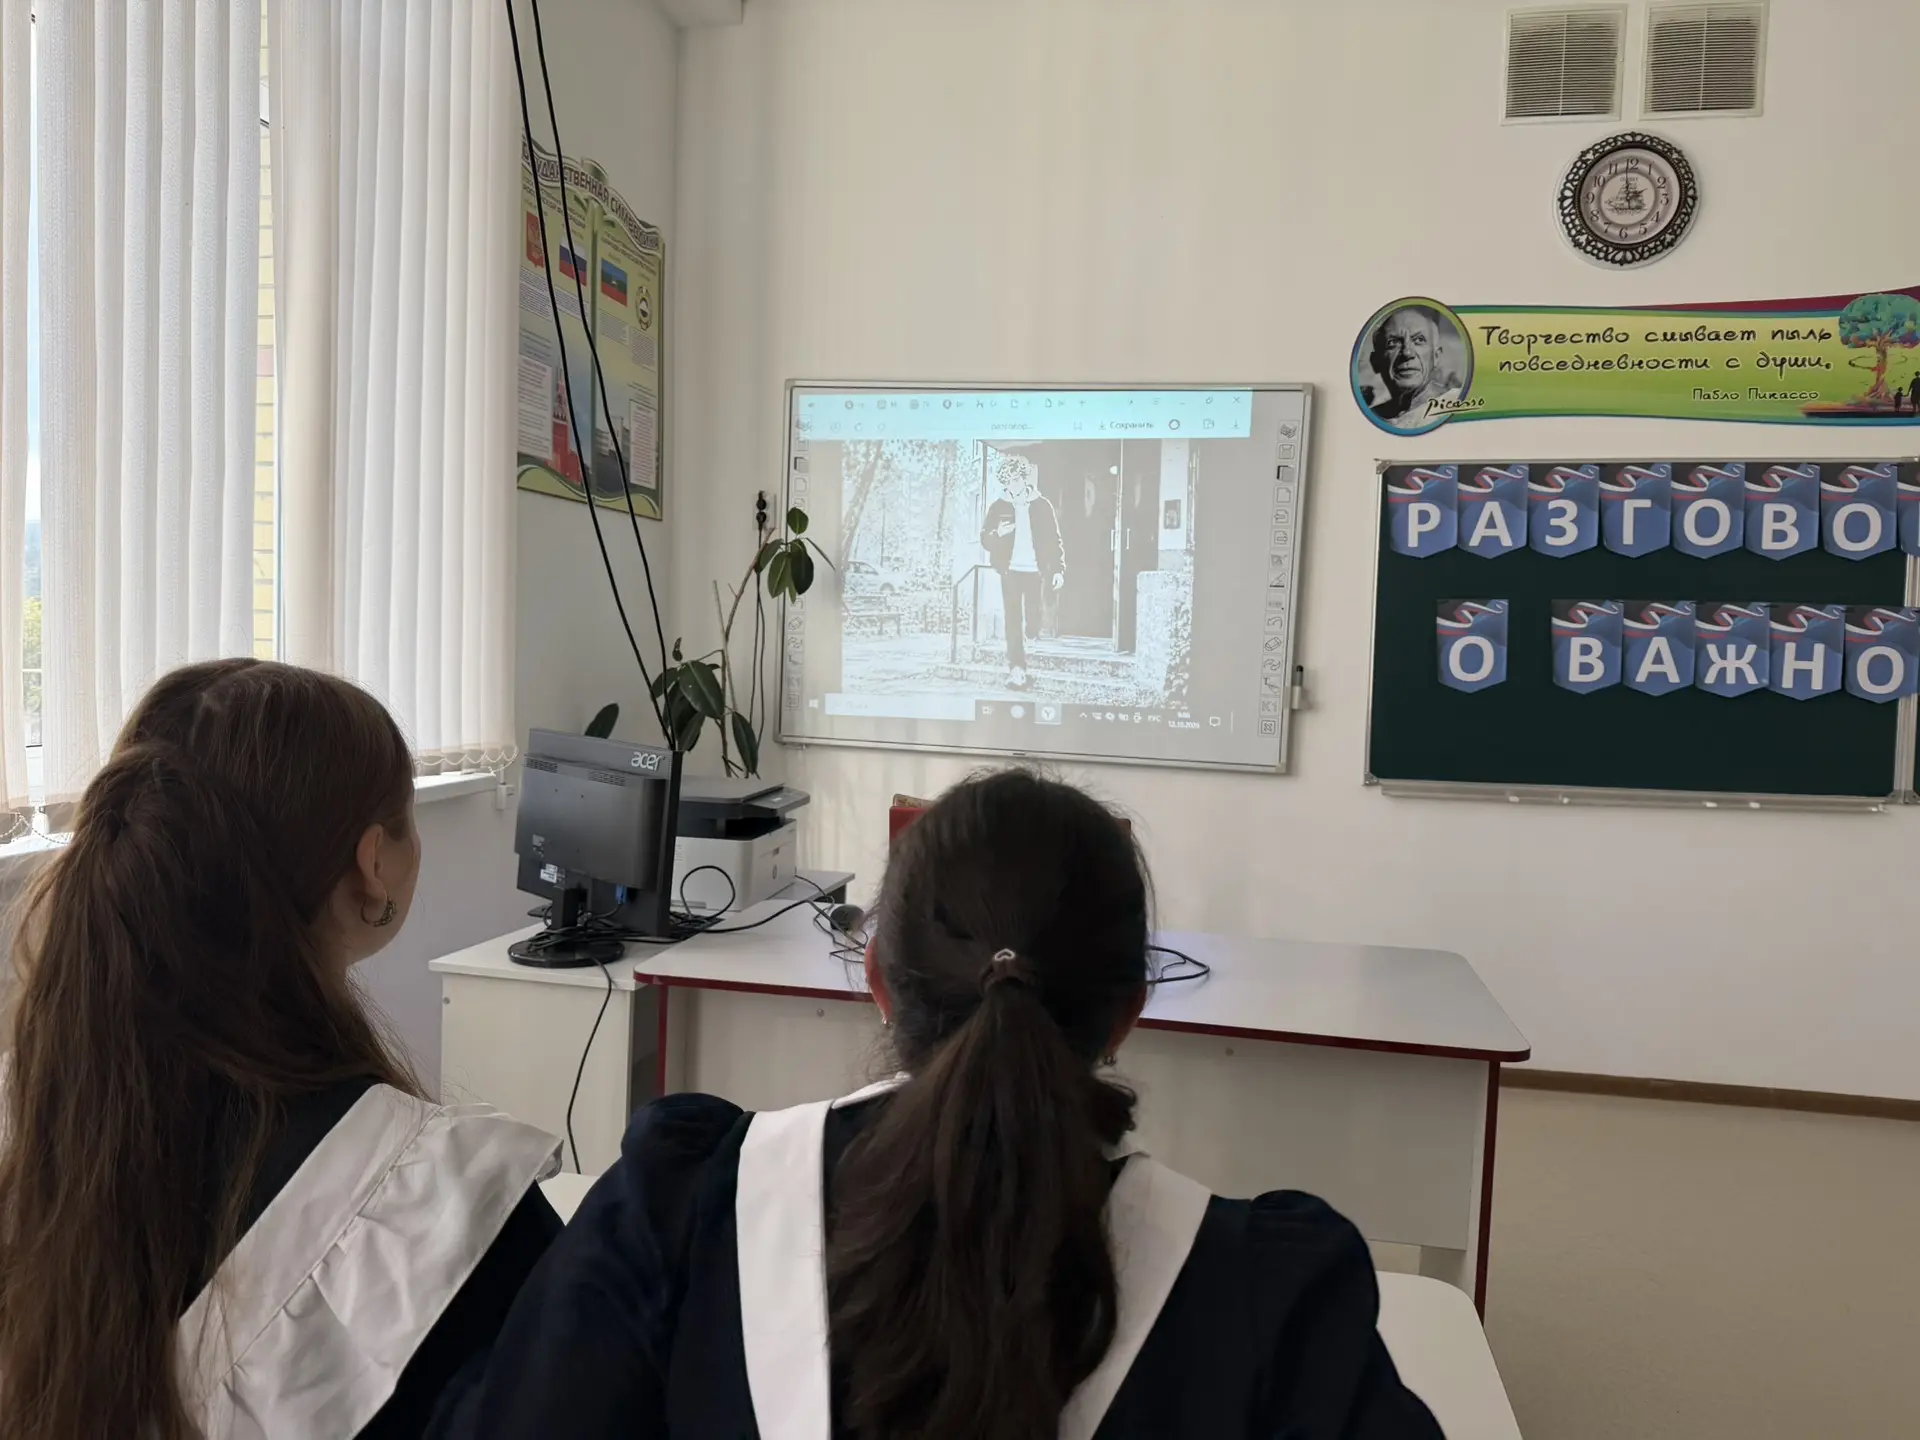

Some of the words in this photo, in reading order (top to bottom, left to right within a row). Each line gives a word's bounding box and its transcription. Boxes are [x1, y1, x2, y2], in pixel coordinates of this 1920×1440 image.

[1594, 176, 1606, 187] 10
[1656, 177, 1667, 189] 2
[1586, 192, 1595, 204] 9
[1660, 193, 1669, 205] 3
[1590, 210, 1600, 222] 8
[1603, 222, 1612, 234] 7
[1619, 227, 1628, 239] 6
[1638, 223, 1648, 235] 5
[1478, 325, 1630, 354] Творчество
[1645, 325, 1757, 343] смывает
[1771, 327, 1832, 344] пыль
[1499, 354, 1710, 372] повседневности
[1725, 357, 1741, 369] с
[1756, 351, 1832, 379] души.
[1693, 388, 1740, 400] Пабло
[1748, 388, 1819, 400] Пикассо
[1425, 398, 1485, 418] Picasso
[1407, 498, 1920, 552] РАЗГОВО
[1448, 636, 1495, 682] О
[1568, 636, 1904, 694] ВАЖНО
[631, 751, 662, 771] acer
